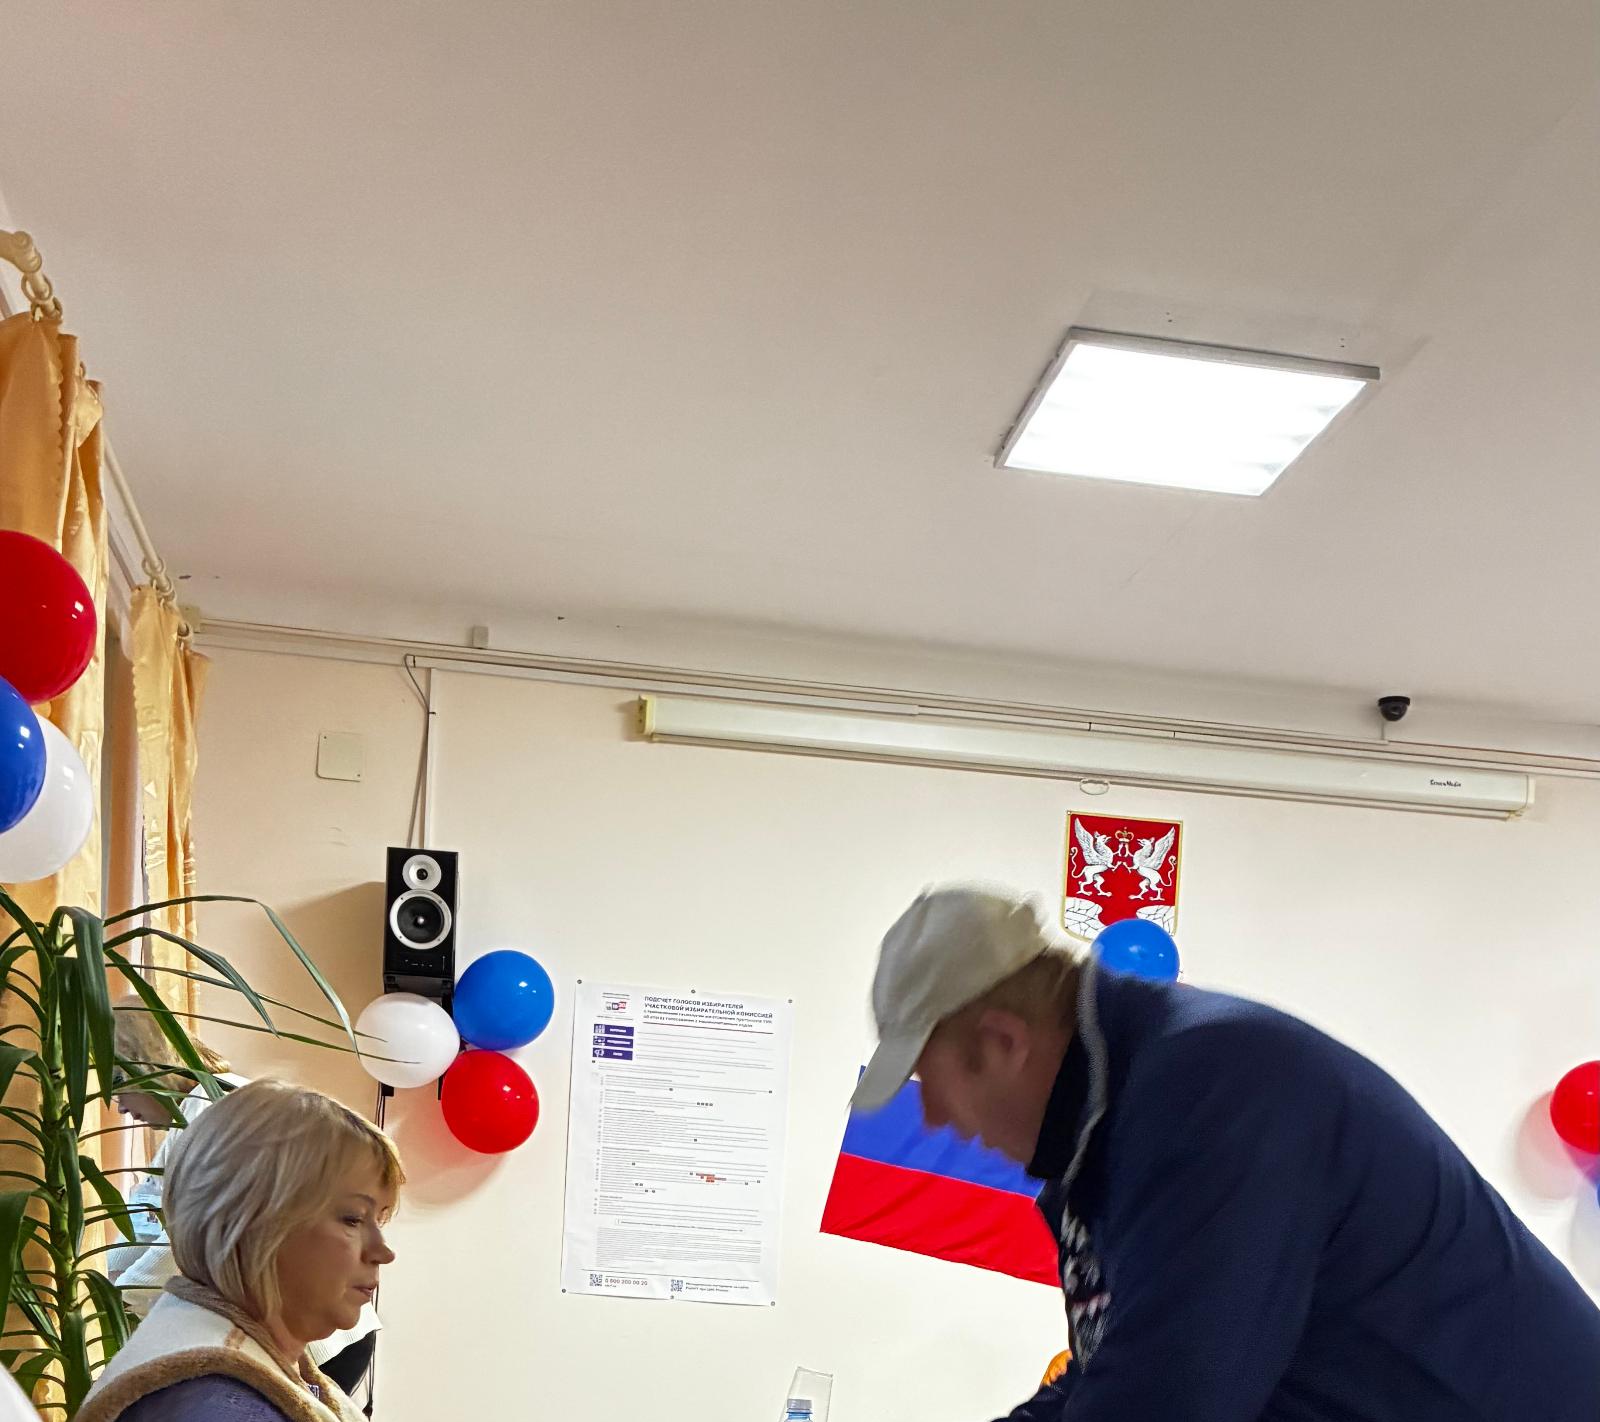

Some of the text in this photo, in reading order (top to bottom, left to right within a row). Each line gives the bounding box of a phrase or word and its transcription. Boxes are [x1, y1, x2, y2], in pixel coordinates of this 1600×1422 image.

[644, 1003, 684, 1011] УЧАСТКОВОЙ
[685, 1006, 736, 1016] ИЗБИРАТЕЛЬНОЙ
[736, 1011, 773, 1019] КОМИССИЕЙ
